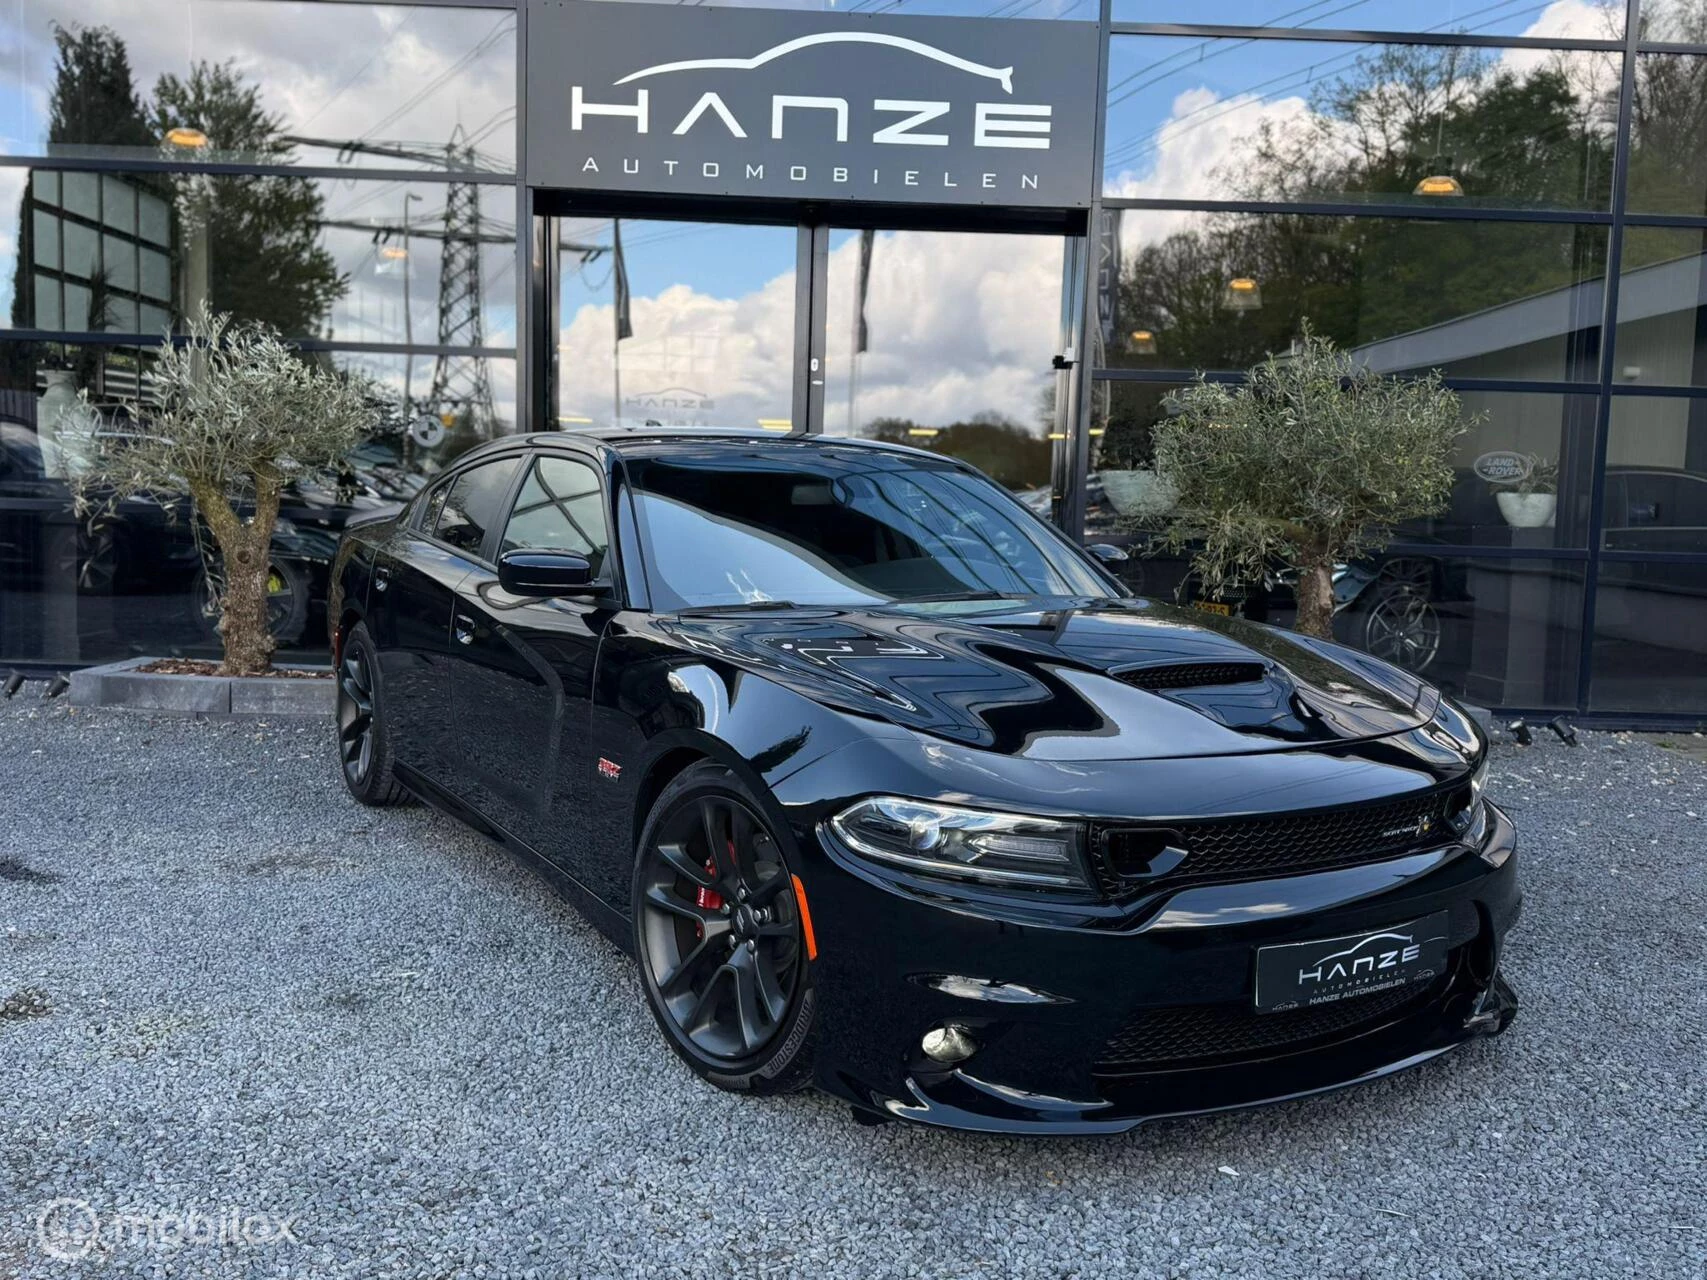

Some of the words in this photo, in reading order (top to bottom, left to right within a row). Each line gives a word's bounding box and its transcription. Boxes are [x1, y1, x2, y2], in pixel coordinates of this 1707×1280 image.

[571, 85, 1052, 149] HANZE
[582, 156, 1038, 189] AUTOMOBIELEN
[1486, 458, 1515, 467] LAND
[1488, 467, 1524, 475] ROVER
[1298, 944, 1420, 985] HANZE
[1309, 993, 1341, 1006] HANZE
[1342, 977, 1406, 999] AUTOMOBIELEN
